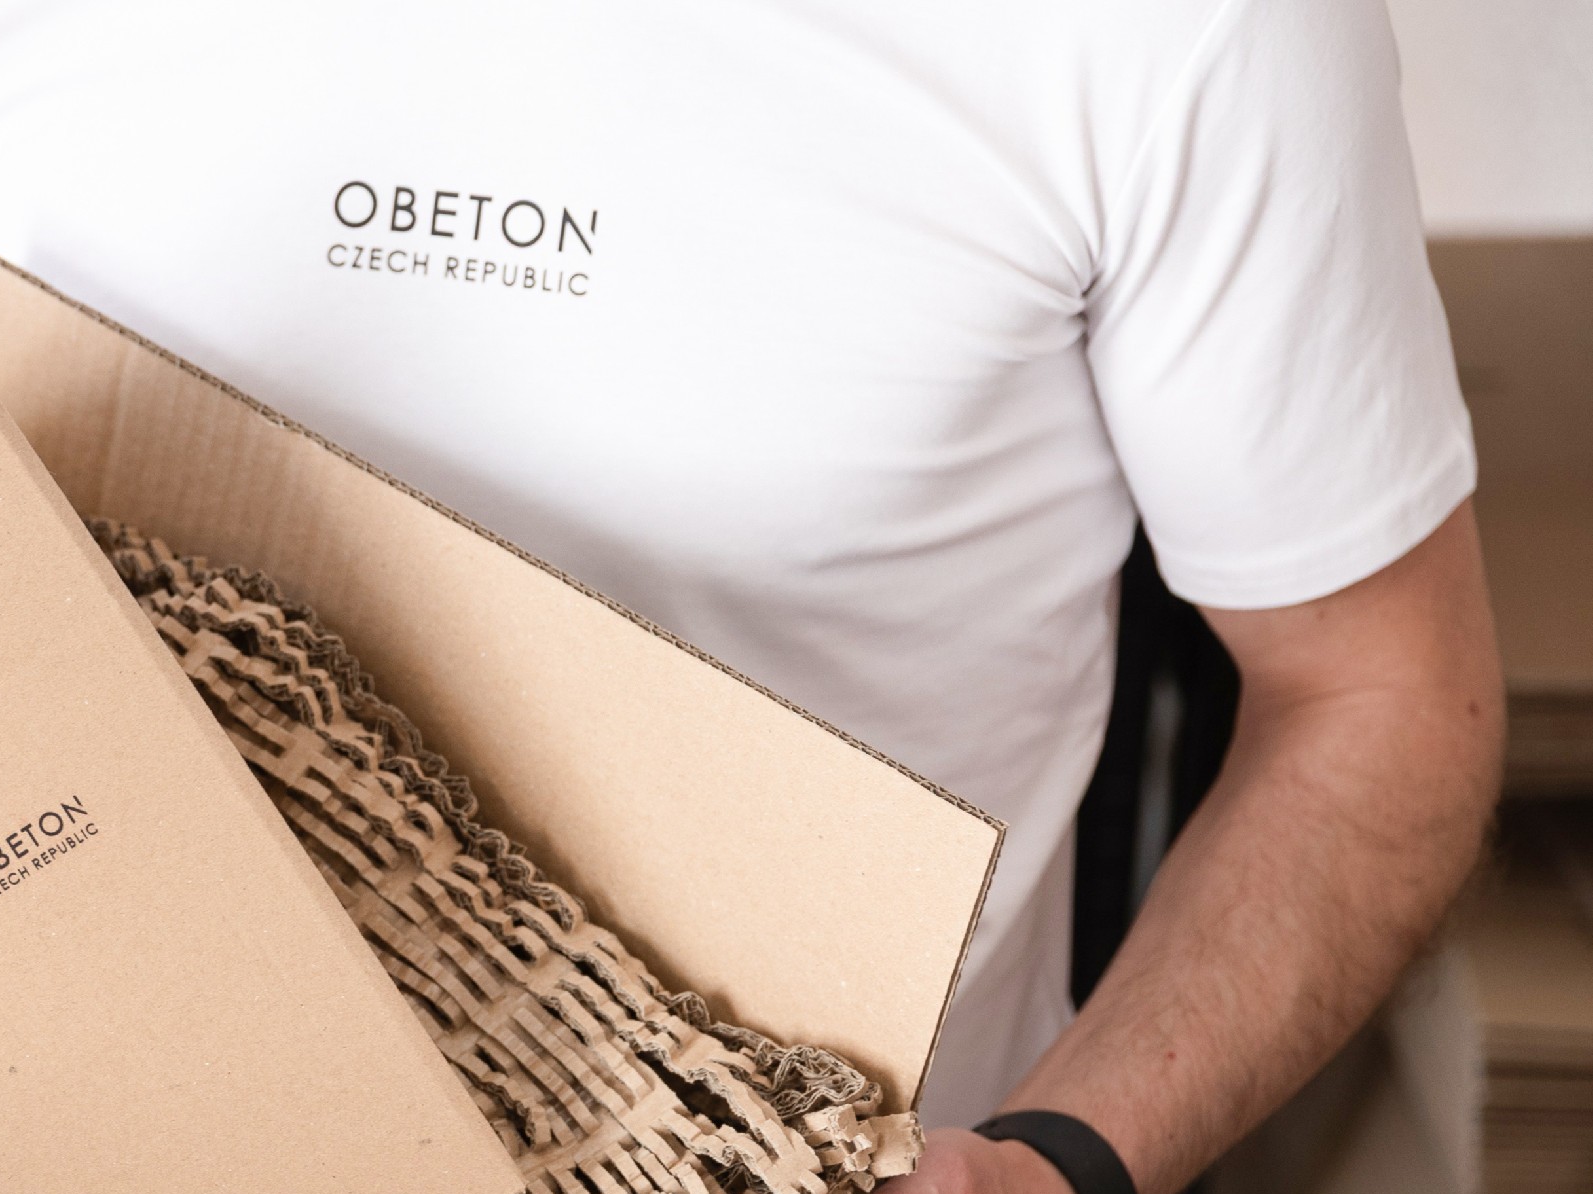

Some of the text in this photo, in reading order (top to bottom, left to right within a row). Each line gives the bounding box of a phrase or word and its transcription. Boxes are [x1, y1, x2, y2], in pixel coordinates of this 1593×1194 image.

[334, 180, 598, 255] OBETON
[327, 243, 589, 296] CZECH REPUBLIC
[31, 822, 99, 870] REPUBLIC
